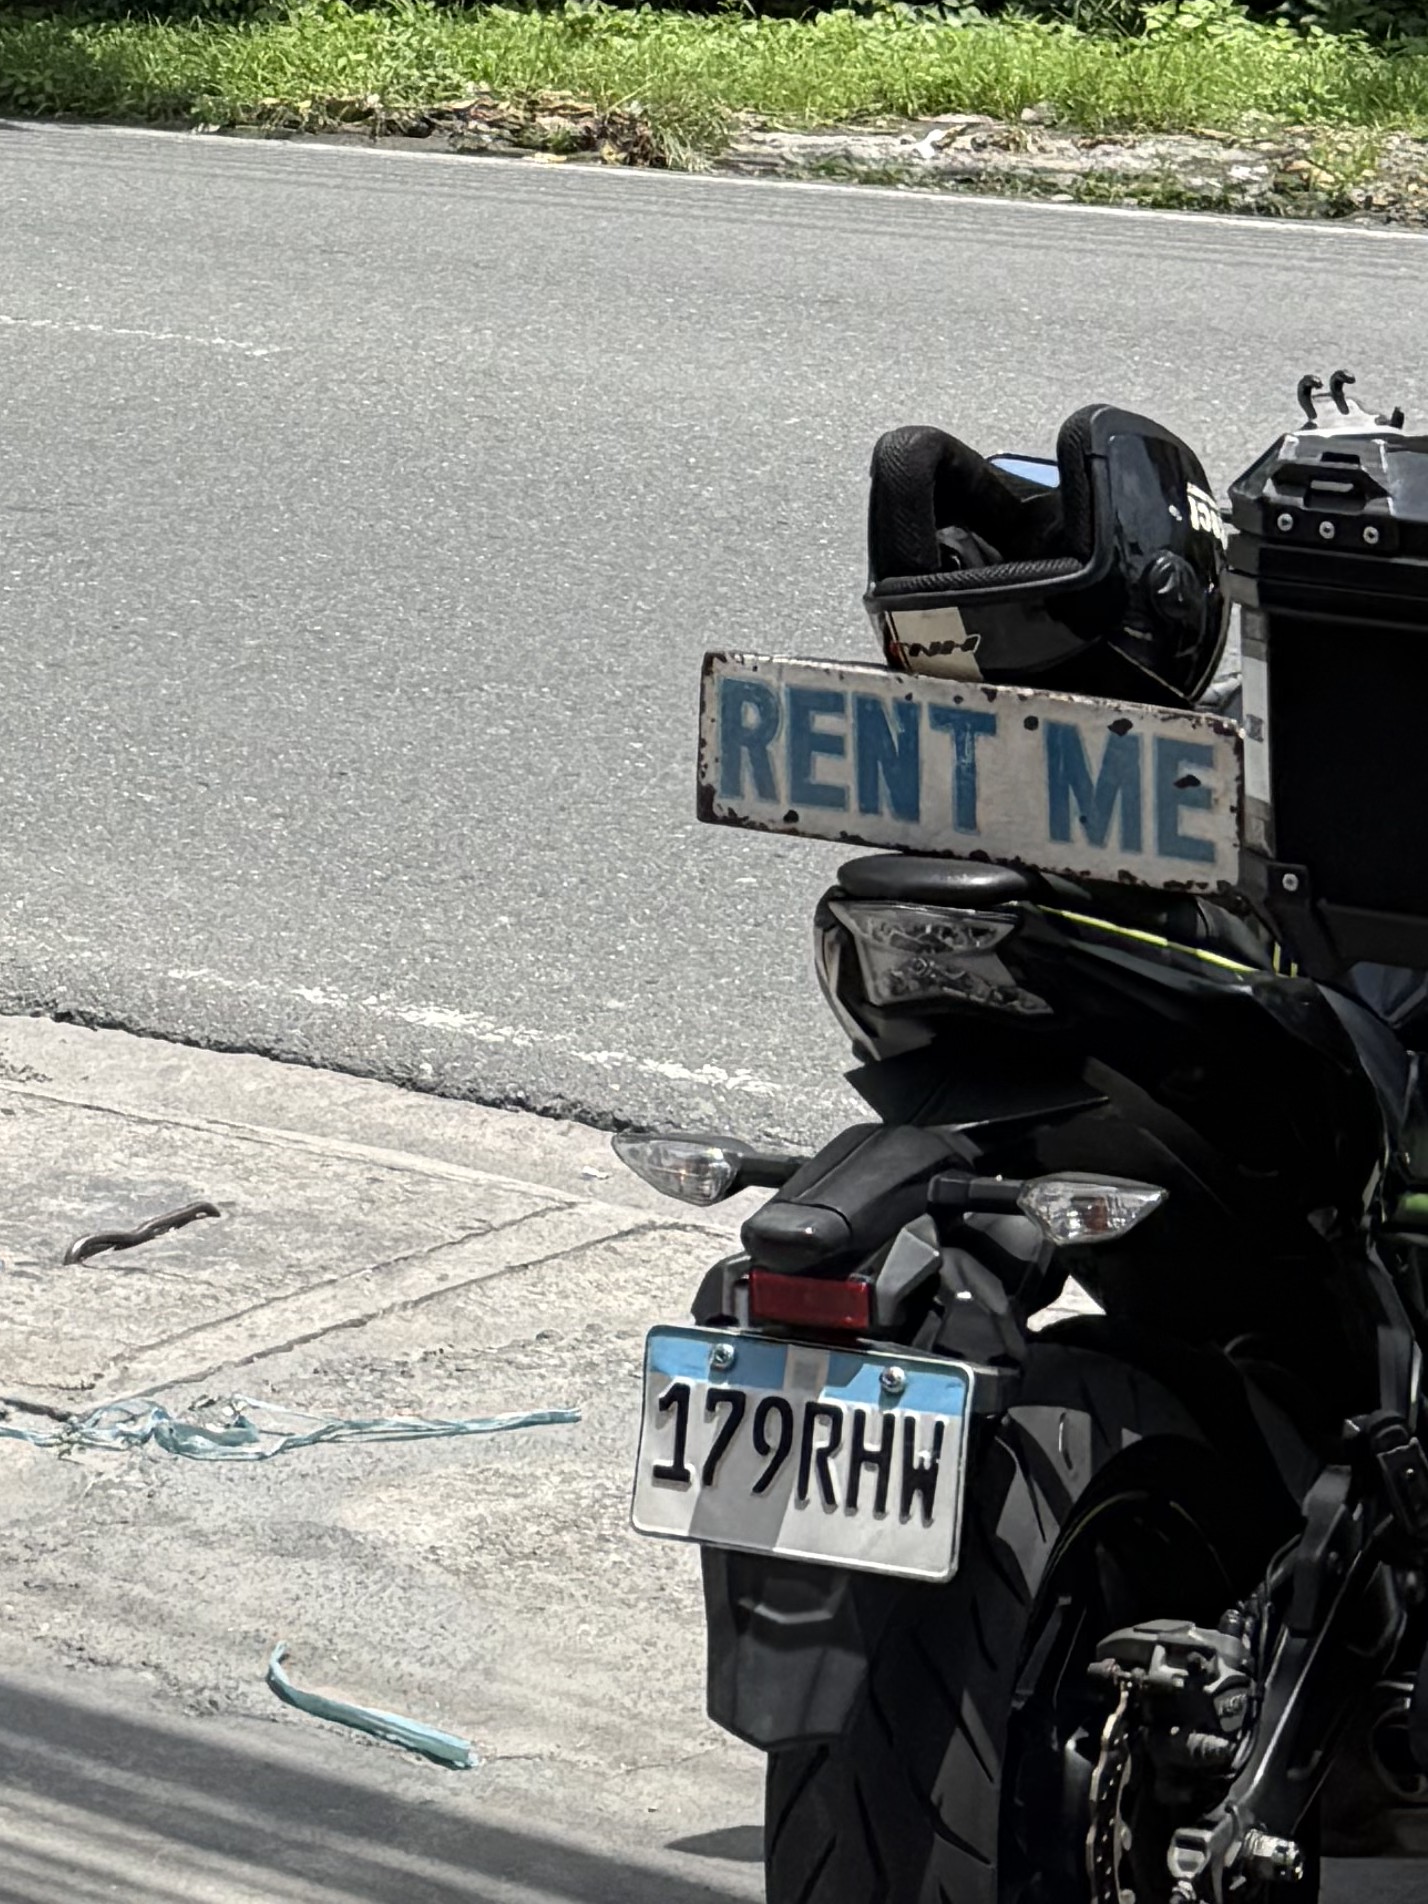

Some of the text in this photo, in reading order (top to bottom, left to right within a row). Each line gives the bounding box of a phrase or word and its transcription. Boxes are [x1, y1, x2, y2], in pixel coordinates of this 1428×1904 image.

[717, 676, 1216, 864] RENT ME
[653, 1382, 945, 1522] 179RHW
